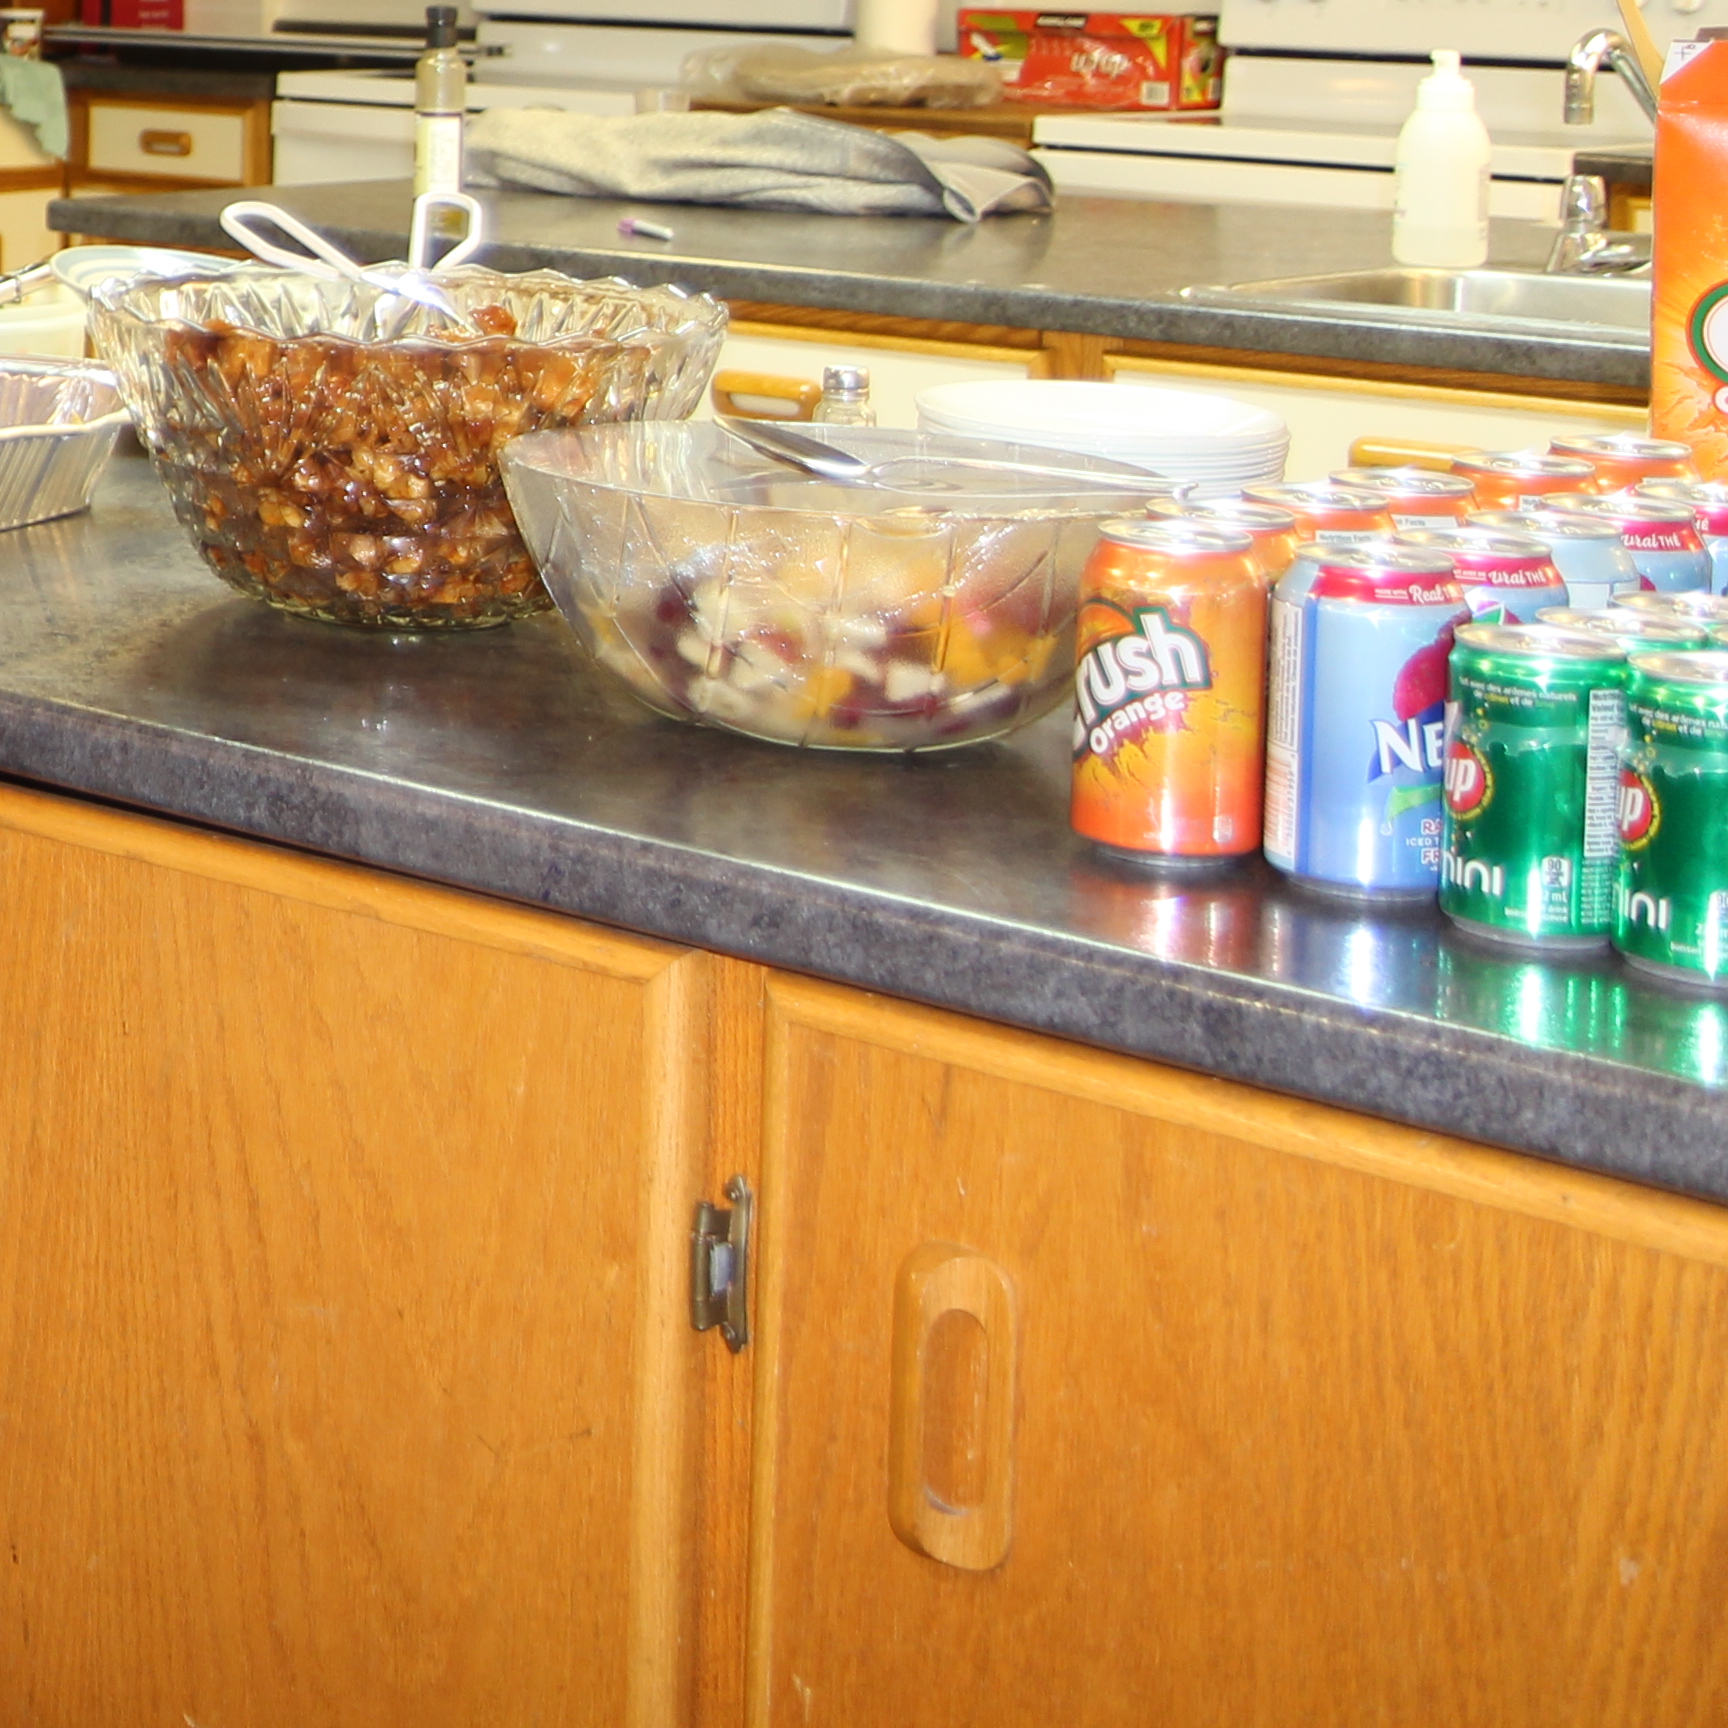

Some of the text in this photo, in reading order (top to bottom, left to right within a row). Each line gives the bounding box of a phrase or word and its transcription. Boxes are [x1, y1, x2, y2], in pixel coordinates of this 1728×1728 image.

[1408, 583, 1444, 604] Real
[1089, 690, 1185, 754] orange
[1369, 718, 1443, 774] NE
[1405, 836, 1433, 847] ICED
